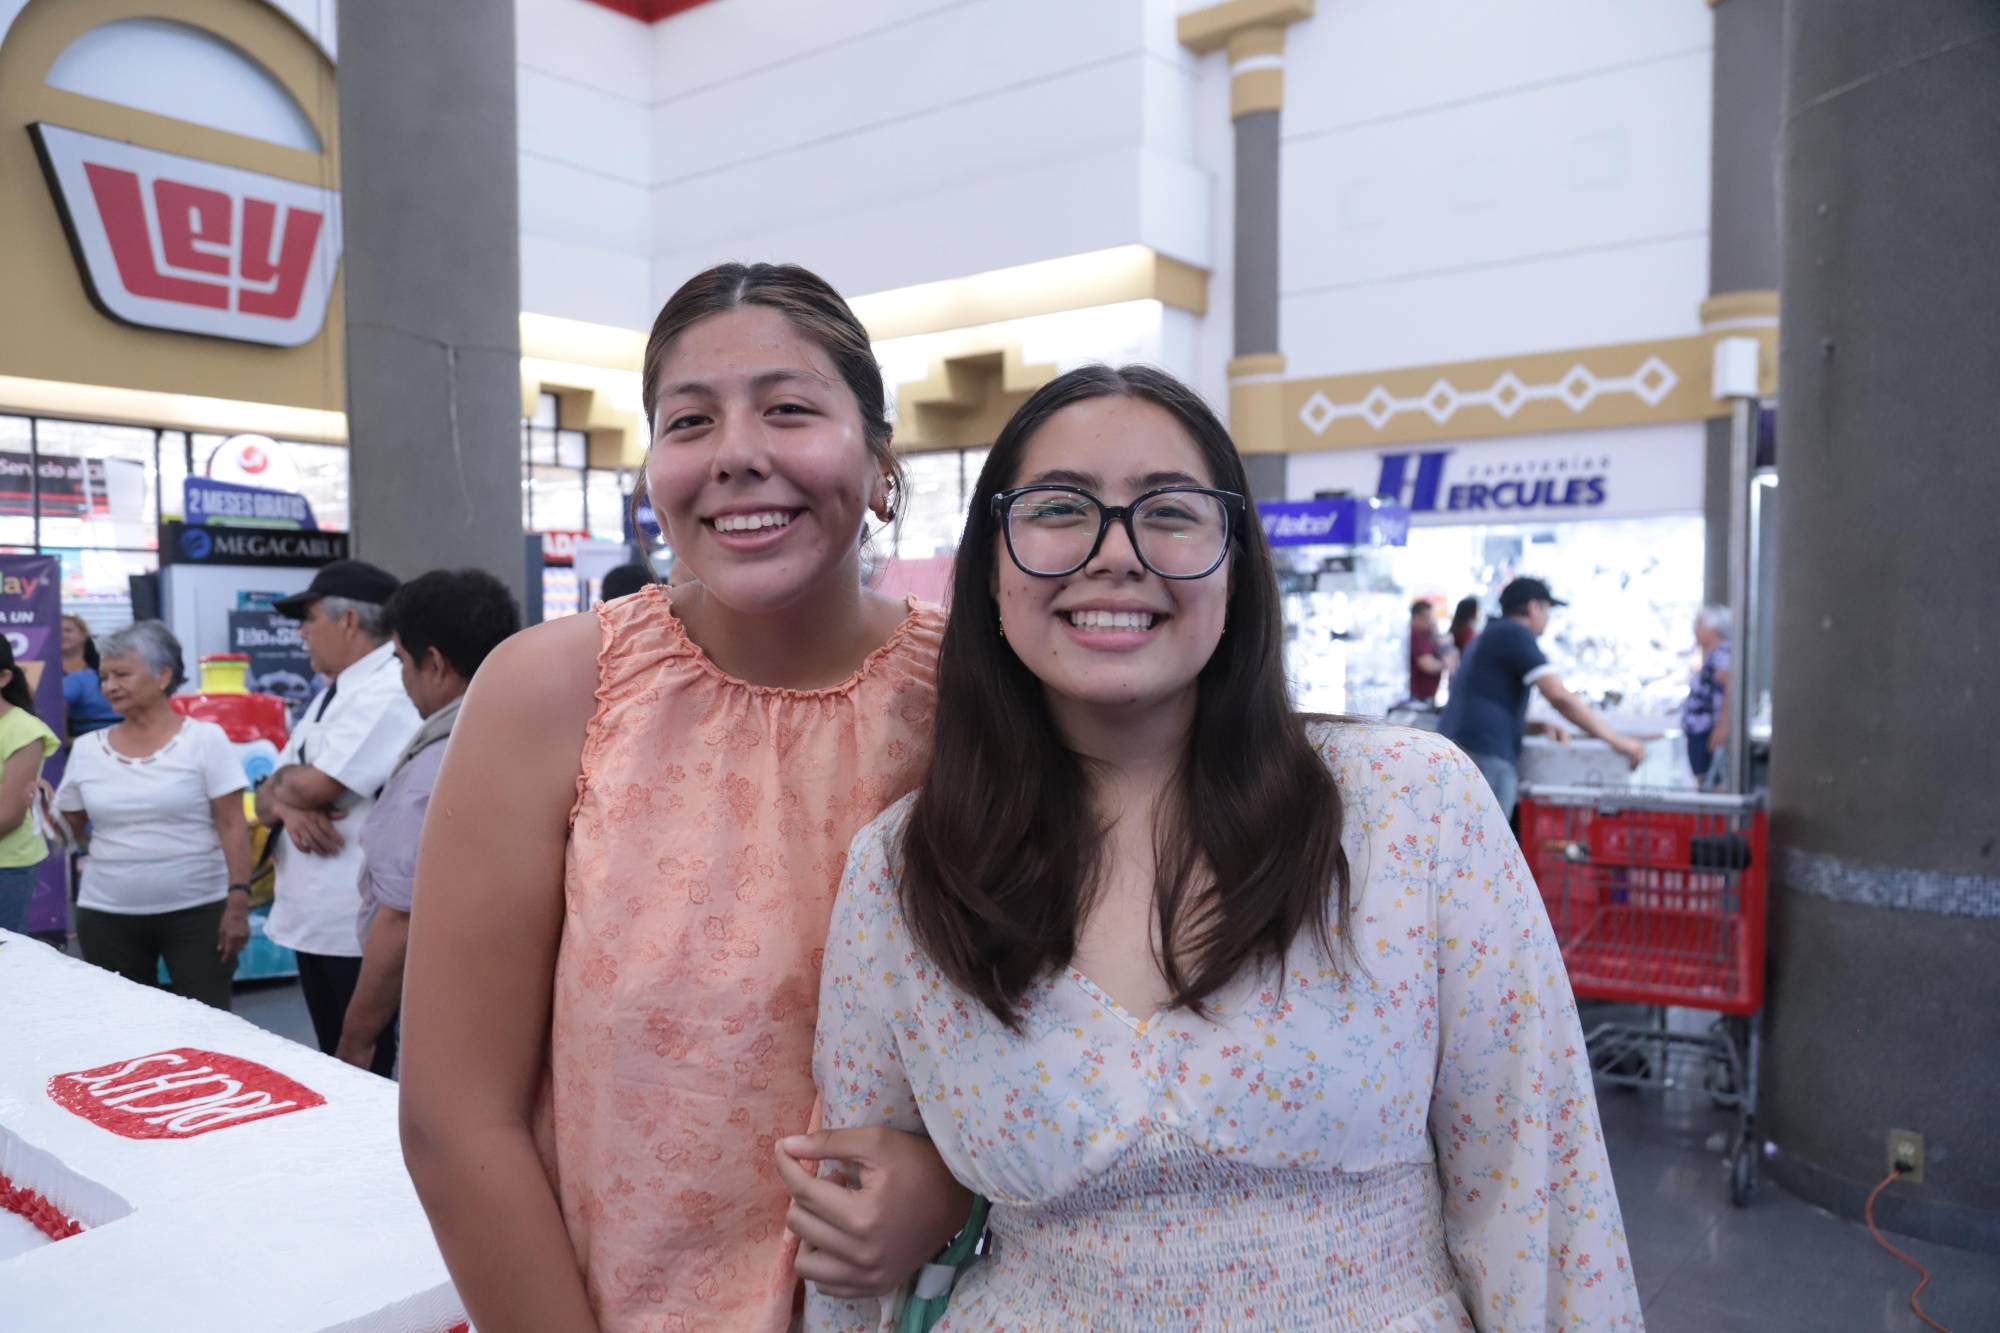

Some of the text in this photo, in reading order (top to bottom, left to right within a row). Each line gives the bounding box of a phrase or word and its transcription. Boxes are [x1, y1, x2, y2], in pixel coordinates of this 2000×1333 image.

[82, 160, 323, 321] Ley
[1377, 450, 1606, 513] HERCULES
[189, 487, 201, 514] 2
[202, 489, 253, 517] MESES
[214, 534, 342, 558] MEGACABLE
[10, 611, 35, 623] UN
